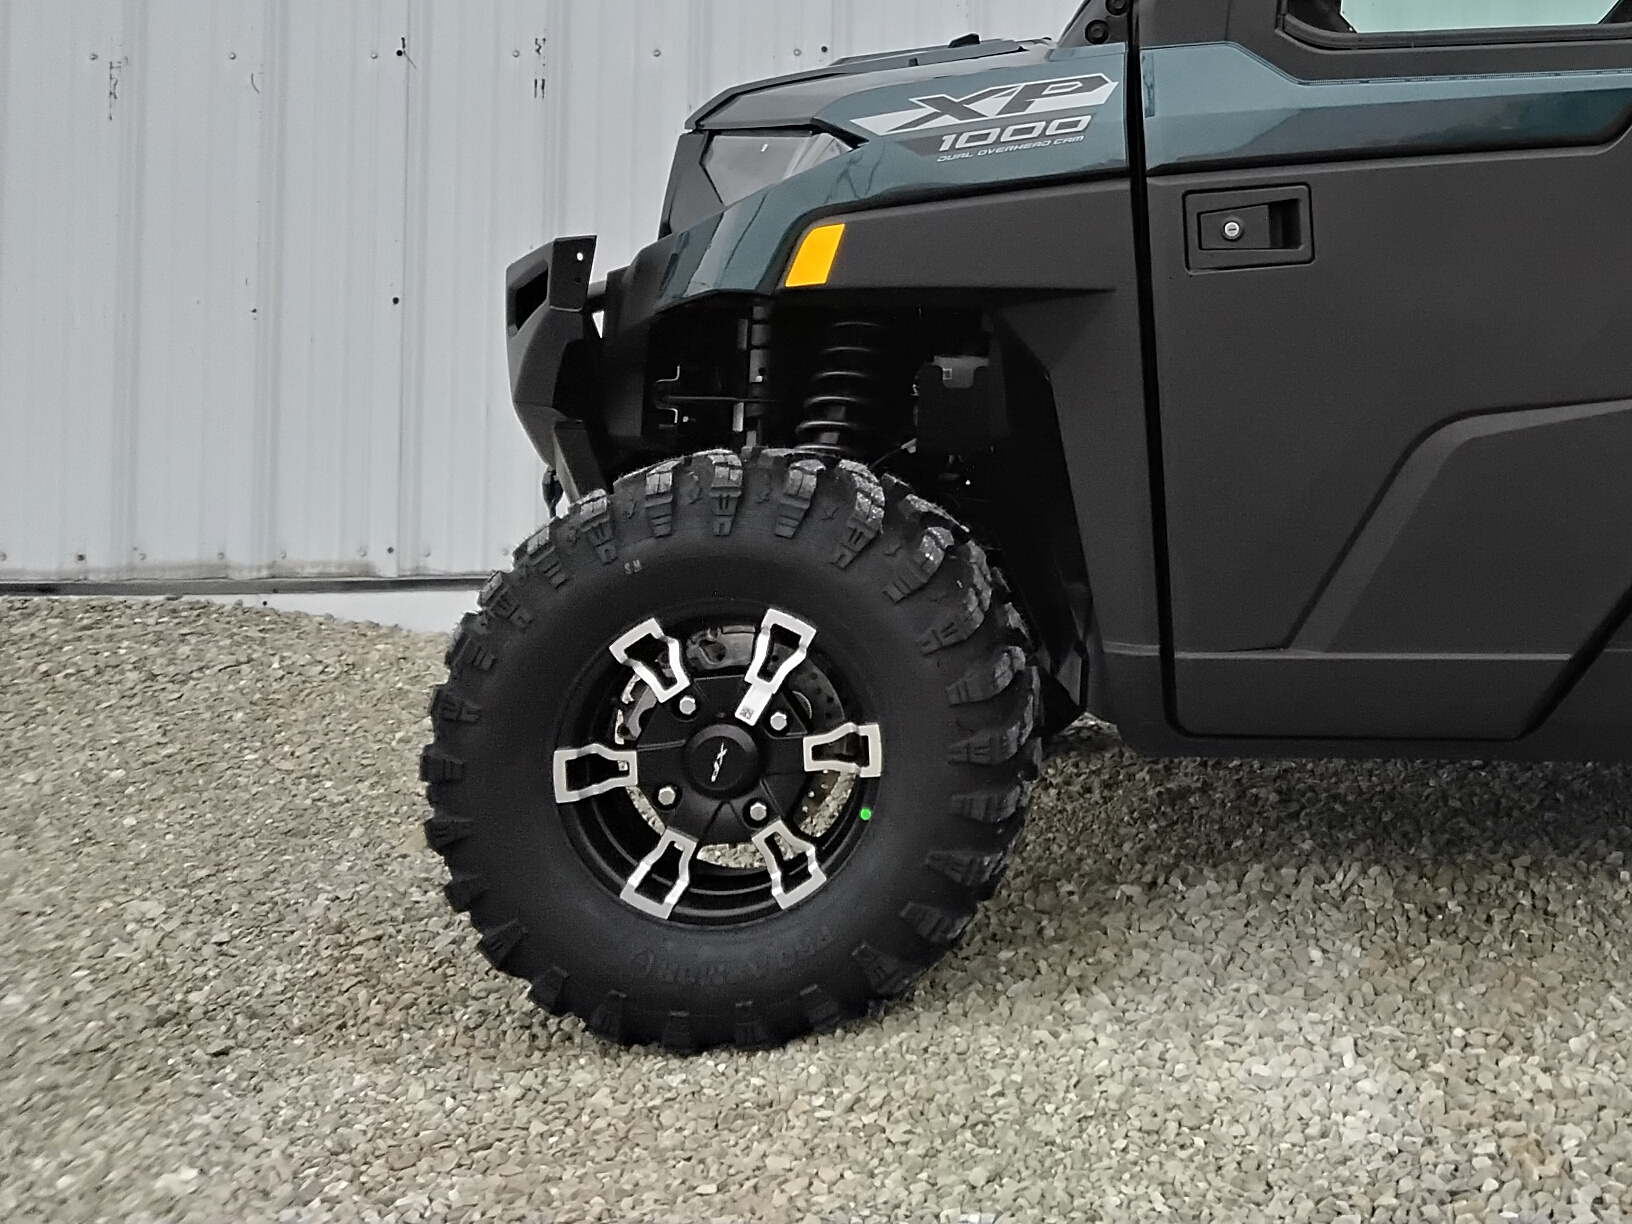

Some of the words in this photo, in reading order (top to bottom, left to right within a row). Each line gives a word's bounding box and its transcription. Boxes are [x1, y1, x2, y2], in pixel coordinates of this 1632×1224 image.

[884, 73, 1111, 133] XP
[937, 151, 973, 162] DUAL
[976, 139, 1050, 157] OVERHEAD
[1053, 135, 1085, 145] CAM
[938, 115, 1092, 152] 1000
